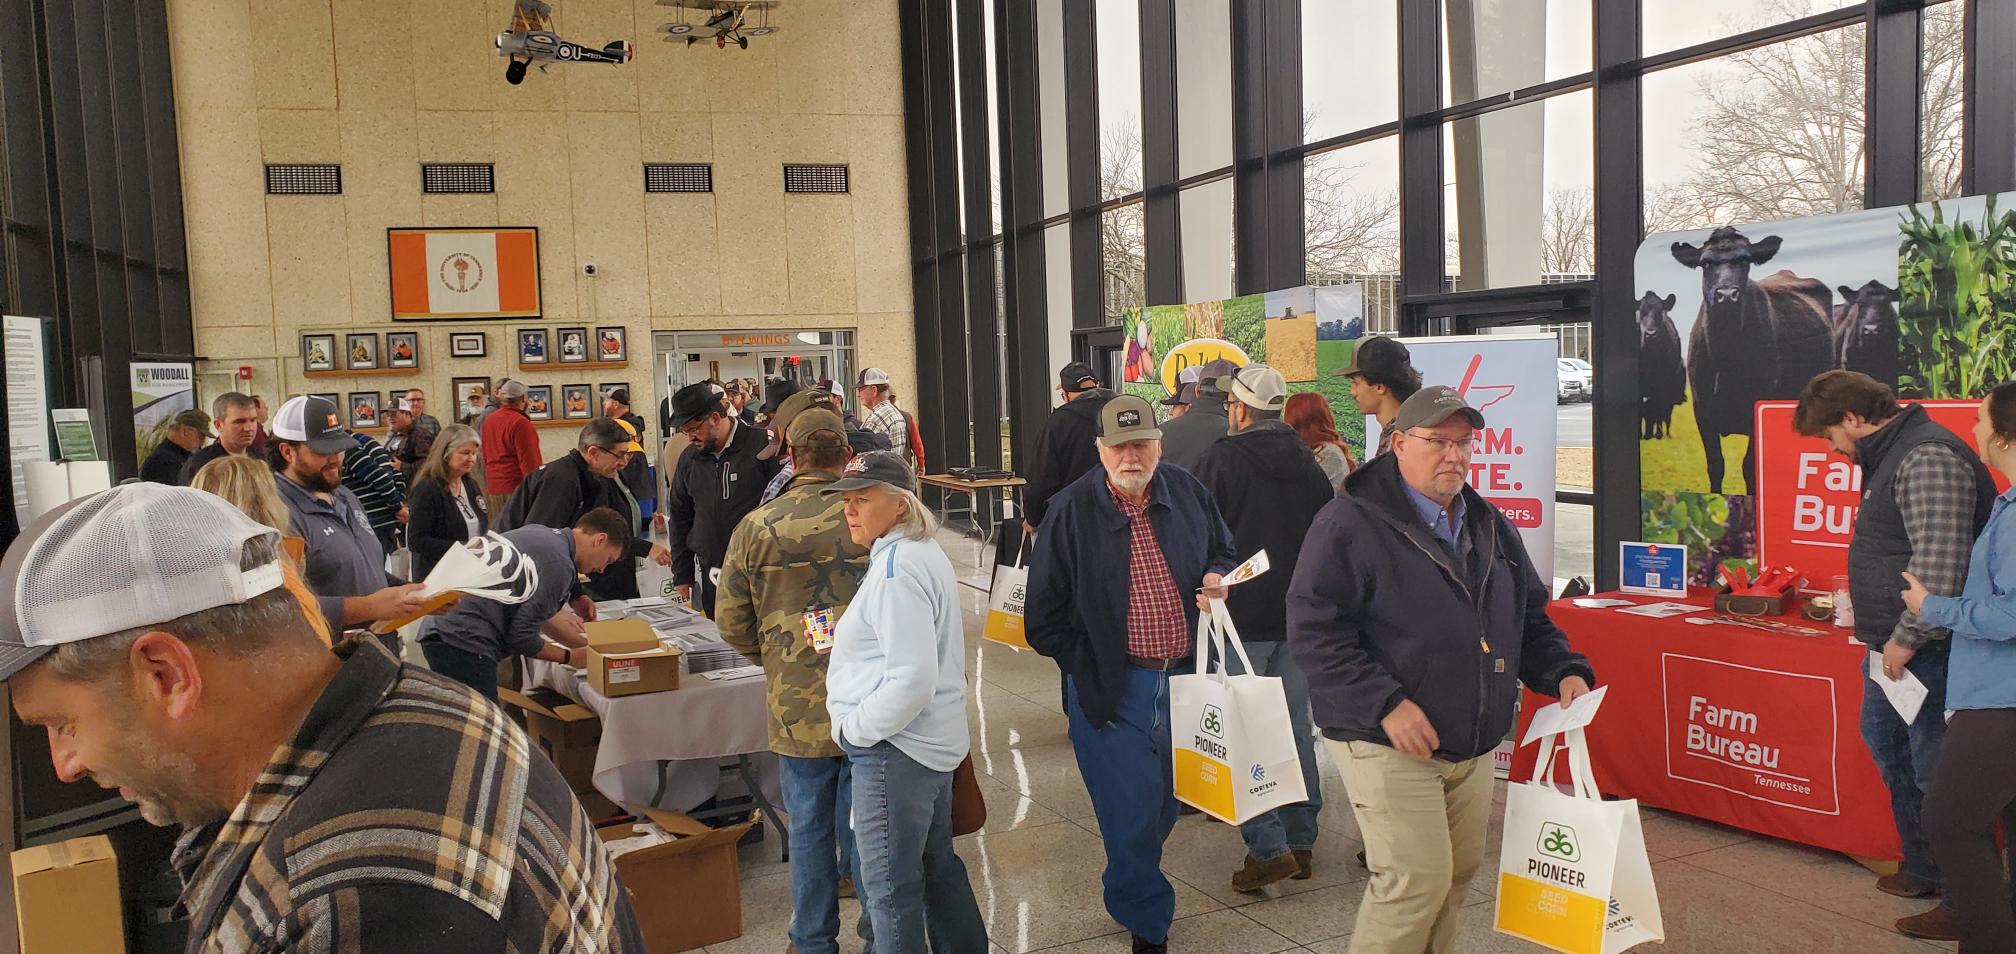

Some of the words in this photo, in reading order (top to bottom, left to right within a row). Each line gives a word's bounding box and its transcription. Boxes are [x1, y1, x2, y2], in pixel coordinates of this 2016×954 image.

[573, 46, 581, 60] U
[748, 334, 791, 345] WINGS
[151, 368, 189, 380] WOODALL
[1472, 427, 1524, 455] RM.
[1469, 463, 1523, 491] TE.
[1797, 453, 1863, 492] Far
[1499, 507, 1535, 521] ters.
[1003, 602, 1024, 615] PIONEE
[612, 659, 635, 668] ULINE
[1689, 695, 1758, 735] Farm
[1194, 735, 1227, 760] PIONEER
[1686, 723, 1780, 769] Bureau
[1249, 781, 1278, 794] CORTEVA
[1754, 774, 1811, 795] Tennessee
[1528, 858, 1586, 889] PIONEER
[1540, 888, 1568, 905] SEED
